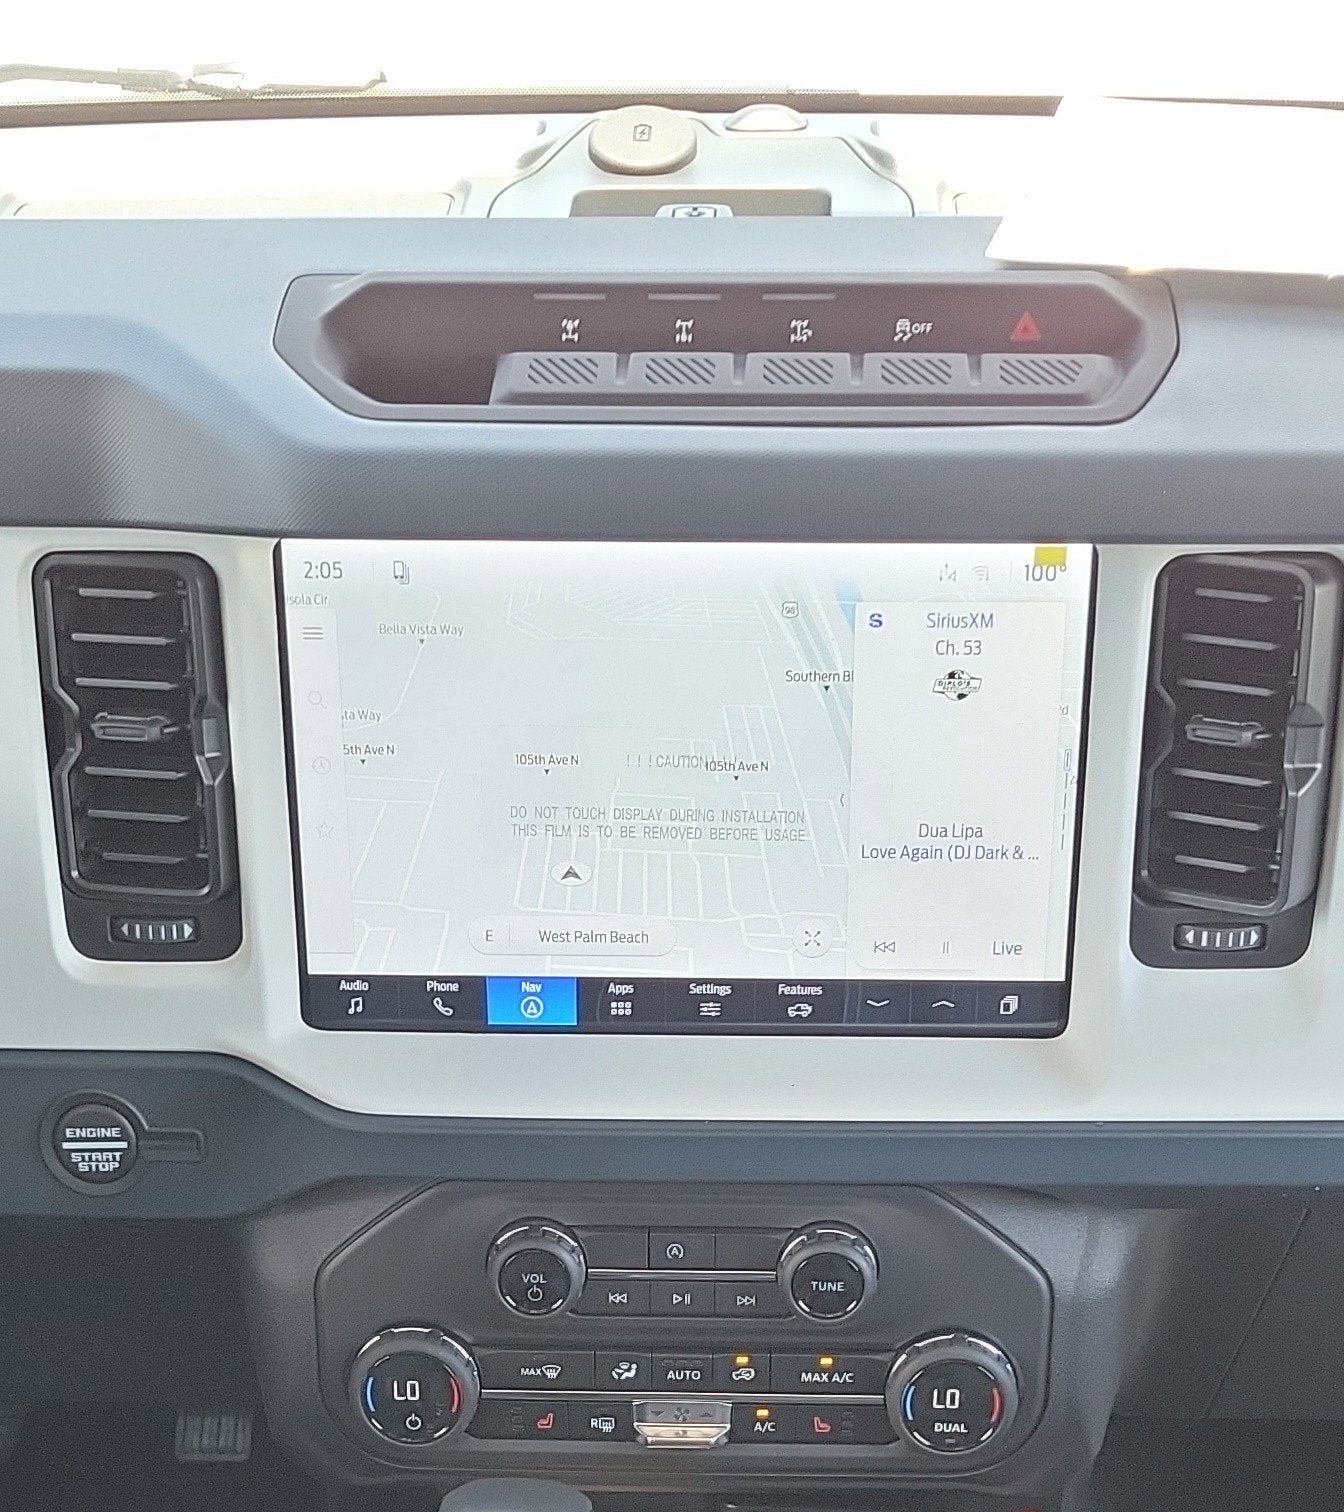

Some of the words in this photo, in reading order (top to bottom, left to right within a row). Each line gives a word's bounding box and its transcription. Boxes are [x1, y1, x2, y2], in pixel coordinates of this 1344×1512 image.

[911, 322, 933, 334] OFF
[304, 561, 343, 580] 2:05
[926, 613, 994, 629] SiriusXM
[379, 623, 406, 636] Bella
[409, 623, 437, 636] Vista
[439, 624, 464, 638] Way
[935, 640, 959, 656] Ch.
[963, 640, 982, 656] 53
[785, 670, 840, 683] Southern
[341, 709, 356, 721] ta
[358, 710, 382, 723] Way
[363, 744, 384, 756] Ave
[386, 744, 395, 756] N
[515, 754, 545, 766] 105th
[548, 755, 569, 766] Ave
[571, 755, 579, 766] N
[656, 755, 707, 769] CAUTION
[738, 761, 758, 772] Ave
[760, 761, 769, 772] N
[510, 806, 528, 819] DO
[534, 807, 559, 819] NOT
[565, 807, 606, 820] TOUCH
[613, 808, 663, 821] DISPLAY
[670, 808, 714, 822] DURING
[722, 810, 805, 825] INSTALLATION
[512, 824, 537, 837] THIS
[544, 824, 571, 837] FILM
[578, 825, 590, 838] IS
[597, 825, 613, 838] TO
[620, 826, 636, 839] BE
[643, 826, 702, 840] REMOVED
[710, 827, 757, 841] BEFORE
[766, 829, 805, 842] USAGE
[918, 824, 948, 838] Dua
[952, 824, 983, 840] Lipa
[861, 845, 897, 859] Love
[900, 845, 943, 861] Again
[947, 845, 971, 862] (DJ
[975, 845, 1009, 860] Dark
[1012, 846, 1024, 860] &
[485, 930, 494, 942] E
[538, 930, 572, 943] West
[574, 930, 607, 943] Palm
[610, 930, 649, 944] Beach
[993, 941, 1022, 956] Live
[339, 979, 369, 992] Audio
[426, 980, 459, 992] Phone
[521, 981, 542, 993] Nav
[608, 983, 634, 996] Apps
[689, 983, 732, 996] Settings
[778, 984, 823, 996] Features
[65, 1127, 122, 1139] ENGINE
[71, 1152, 123, 1162] START
[78, 1162, 120, 1172] STOP
[522, 1273, 547, 1284] VOL
[811, 1281, 845, 1293] TUNE
[520, 1367, 541, 1377] MAX
[667, 1370, 701, 1381] AUTO
[801, 1372, 828, 1383] MAX
[831, 1372, 855, 1384] A/C
[393, 1380, 420, 1401] LO
[932, 1389, 960, 1410] LO
[754, 1421, 776, 1433] A/C
[934, 1422, 968, 1434] DUAL
